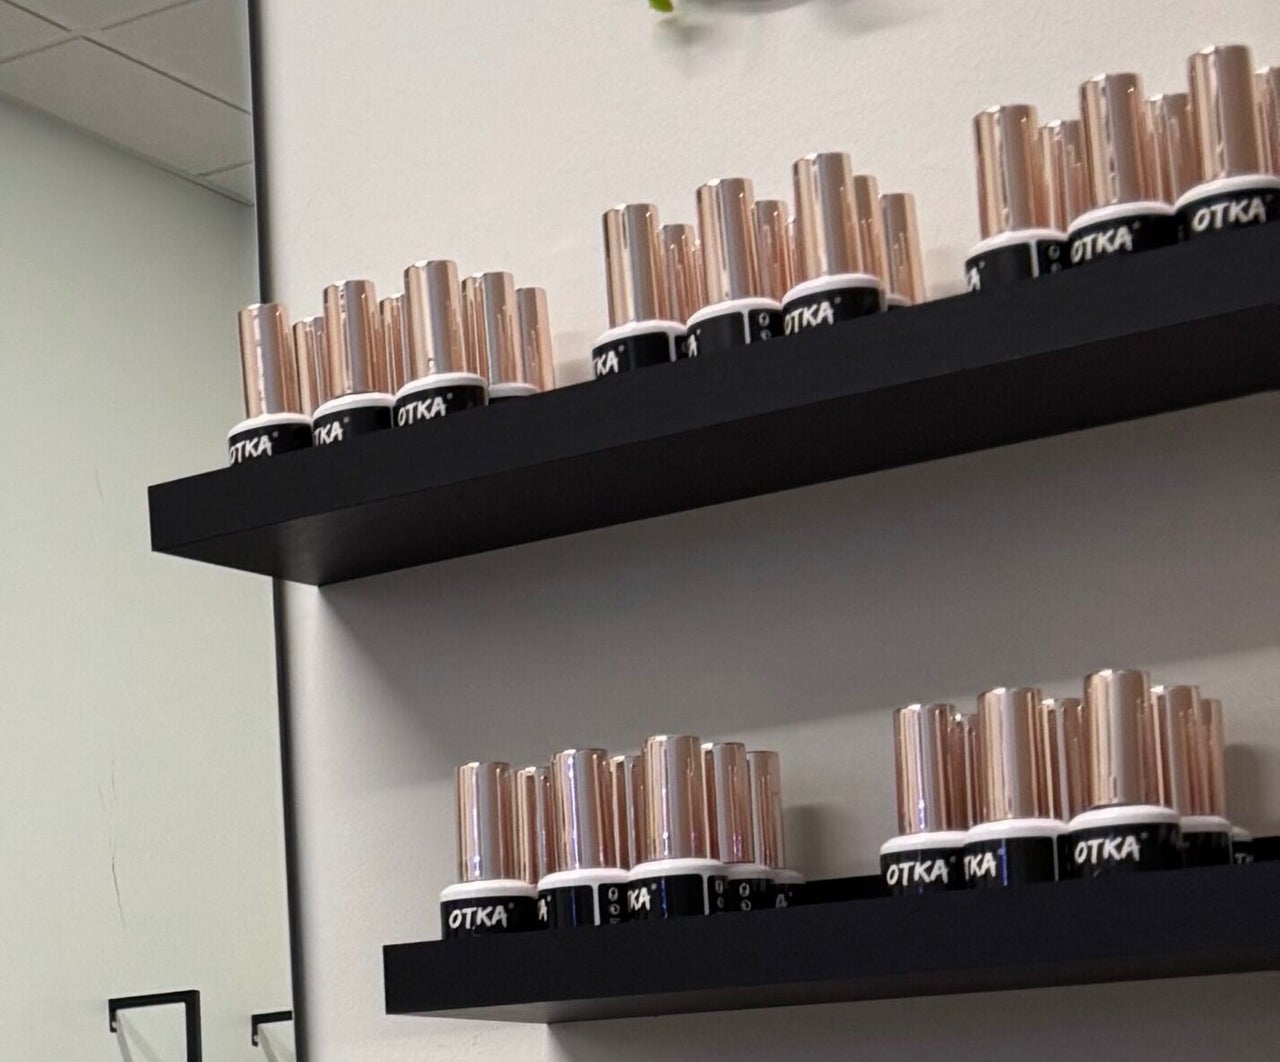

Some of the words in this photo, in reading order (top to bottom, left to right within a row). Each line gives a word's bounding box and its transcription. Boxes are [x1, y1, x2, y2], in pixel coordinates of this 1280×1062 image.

[1192, 197, 1266, 232] OTKA
[1070, 226, 1133, 264] OTKA
[784, 301, 834, 336] OTKA
[398, 396, 446, 428] OTKA
[313, 421, 344, 447] TKA
[1074, 834, 1141, 863] OTKA
[886, 858, 949, 886] OTKA
[963, 851, 997, 881] TKA
[448, 904, 508, 930] OTKA
